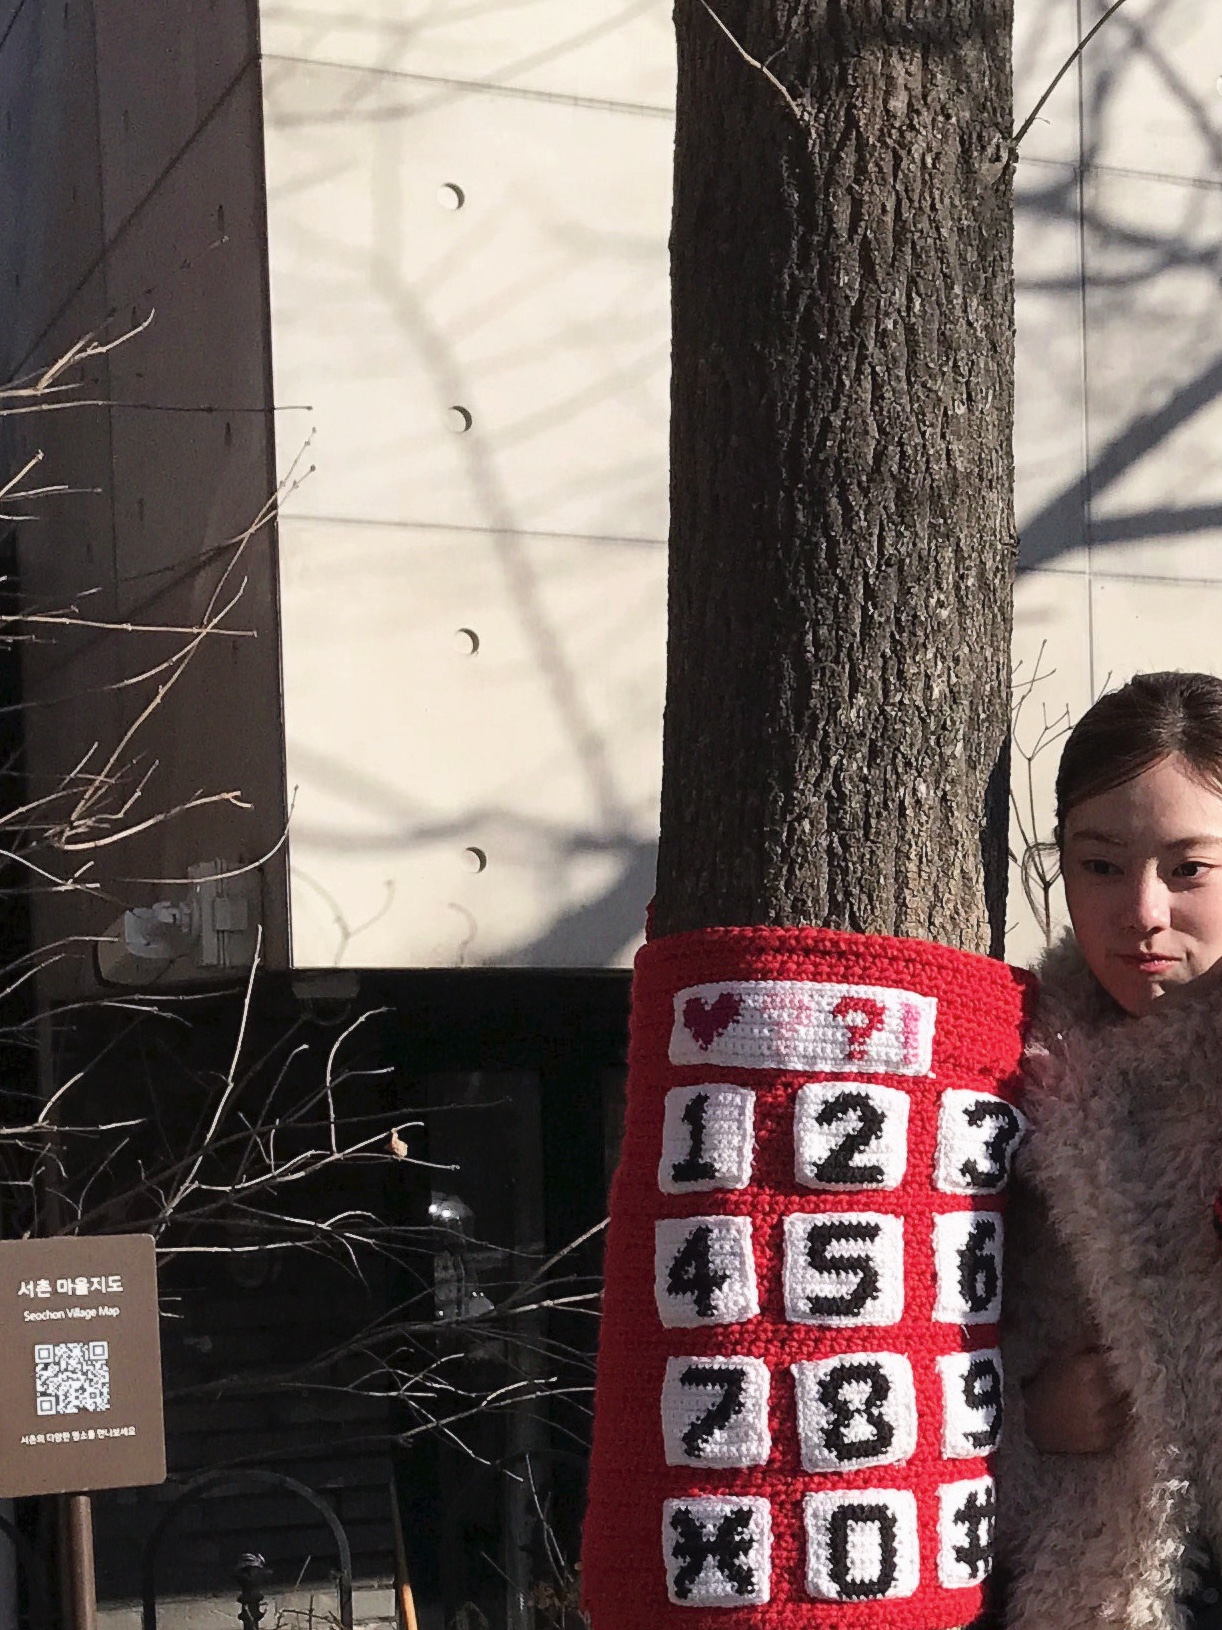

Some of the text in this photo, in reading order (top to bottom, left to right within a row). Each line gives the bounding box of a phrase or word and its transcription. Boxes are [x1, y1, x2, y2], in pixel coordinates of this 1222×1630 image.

[671, 1091, 1020, 1188] 1 2 3
[17, 1275, 124, 1298] 서촌 마을지도
[23, 1305, 120, 1322] Seochon Village Map
[667, 1219, 999, 1317] 4 5 6
[680, 1358, 1004, 1463] 7 8 9
[827, 1503, 899, 1599] 0
